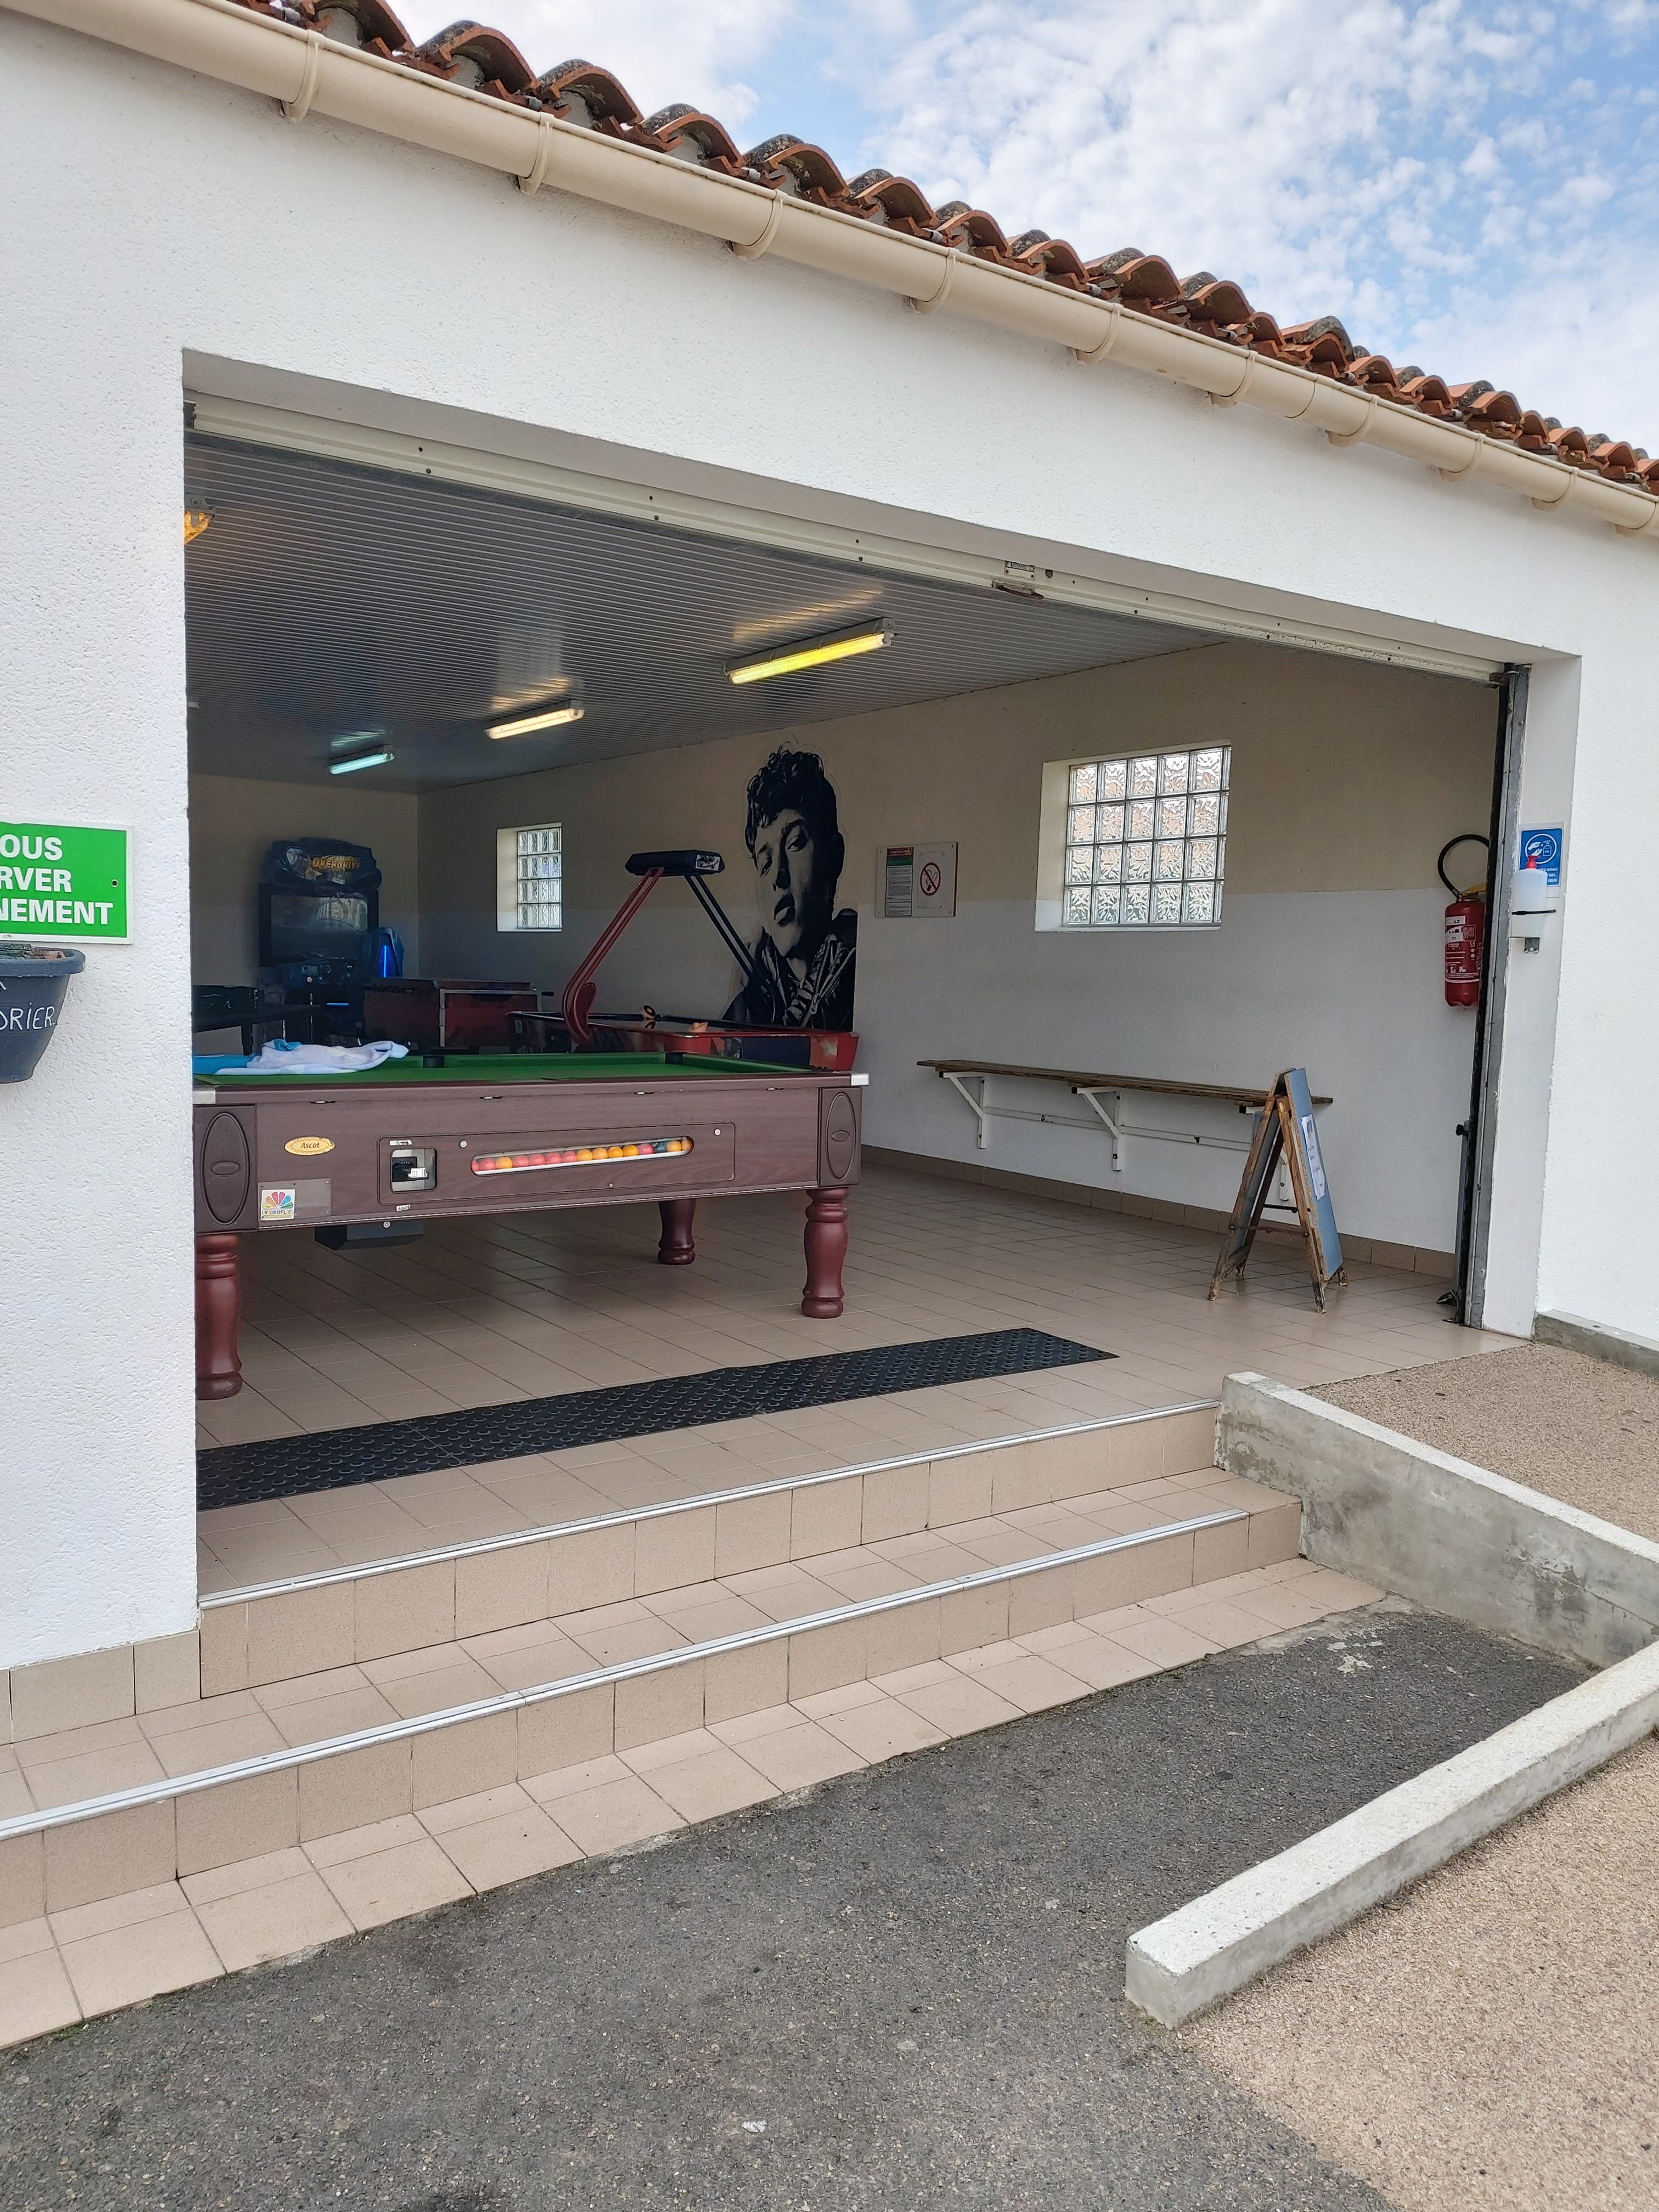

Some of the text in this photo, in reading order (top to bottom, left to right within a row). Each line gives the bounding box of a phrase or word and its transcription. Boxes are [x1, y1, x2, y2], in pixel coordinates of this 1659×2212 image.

[0, 834, 63, 861] OUS
[312, 857, 362, 868] OVERDRIVE
[0, 866, 72, 893] RVER
